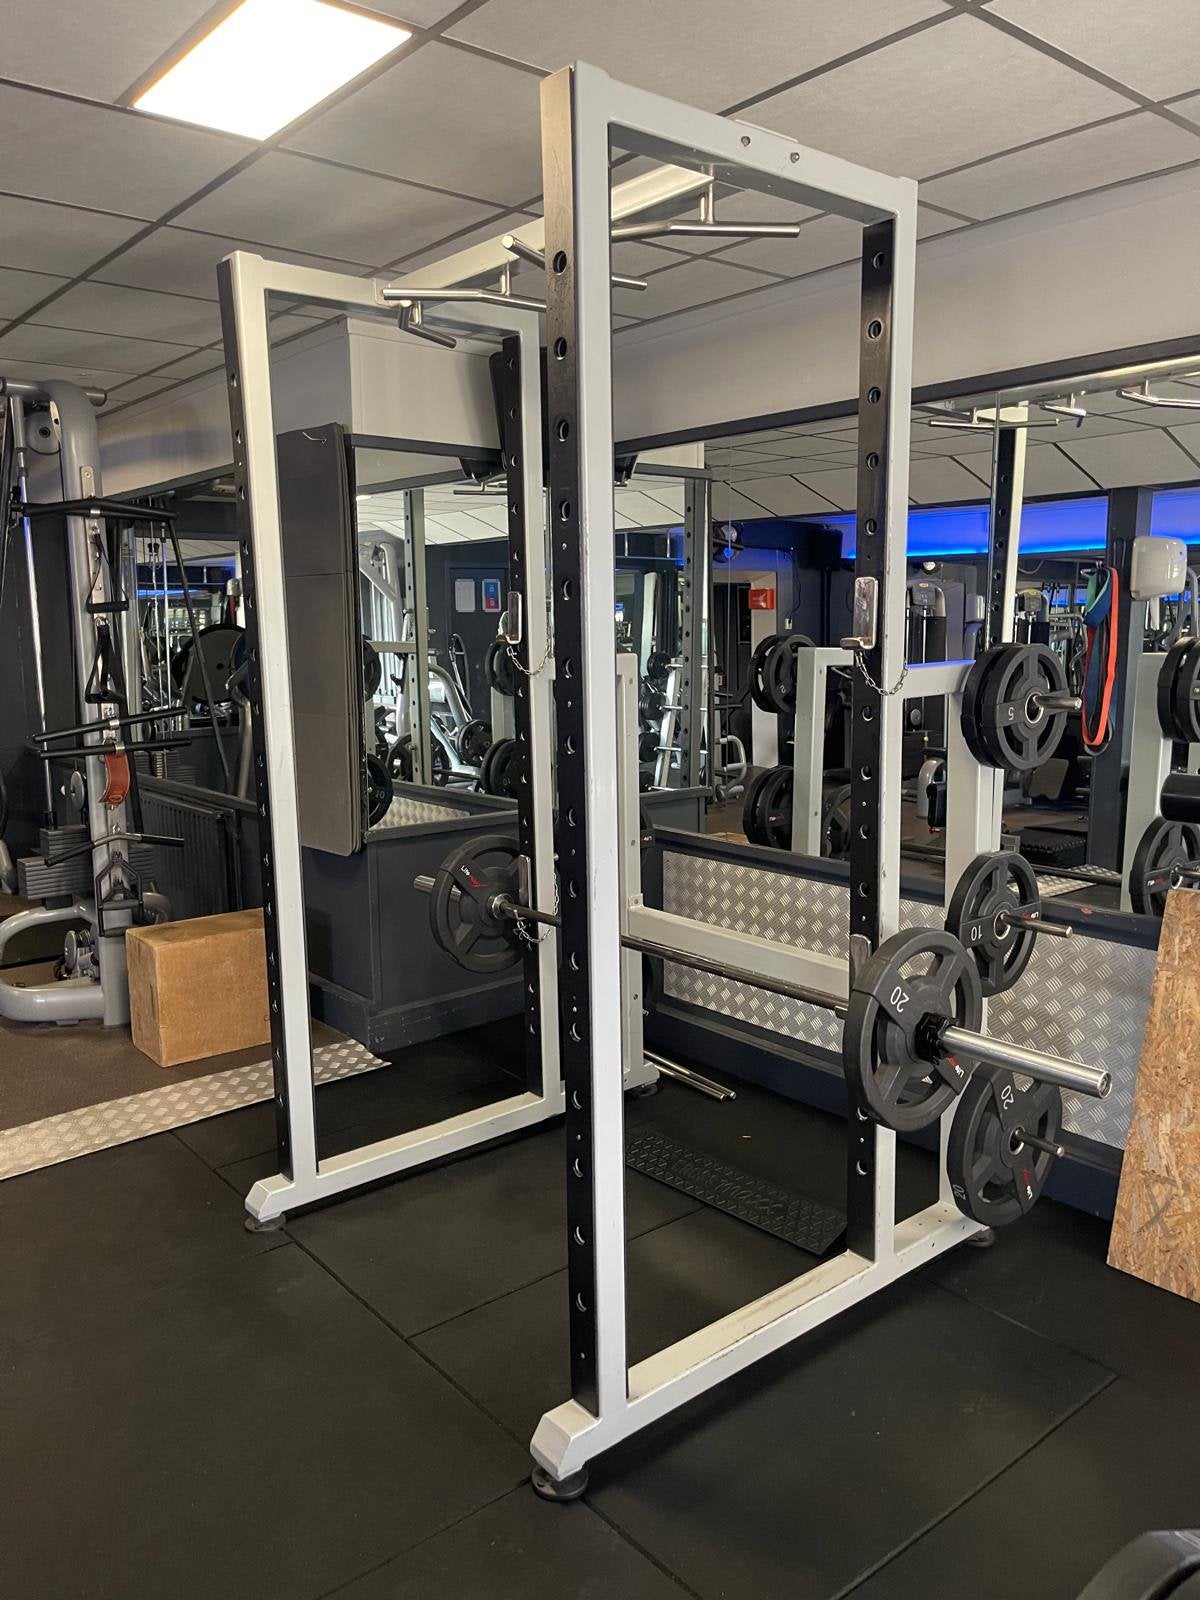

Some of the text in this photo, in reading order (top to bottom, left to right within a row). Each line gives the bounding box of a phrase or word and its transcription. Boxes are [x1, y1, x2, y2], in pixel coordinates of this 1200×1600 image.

[1008, 706, 1014, 721] 5
[970, 925, 982, 941] 10
[890, 986, 910, 1013] 20
[1001, 1085, 1014, 1110] 20
